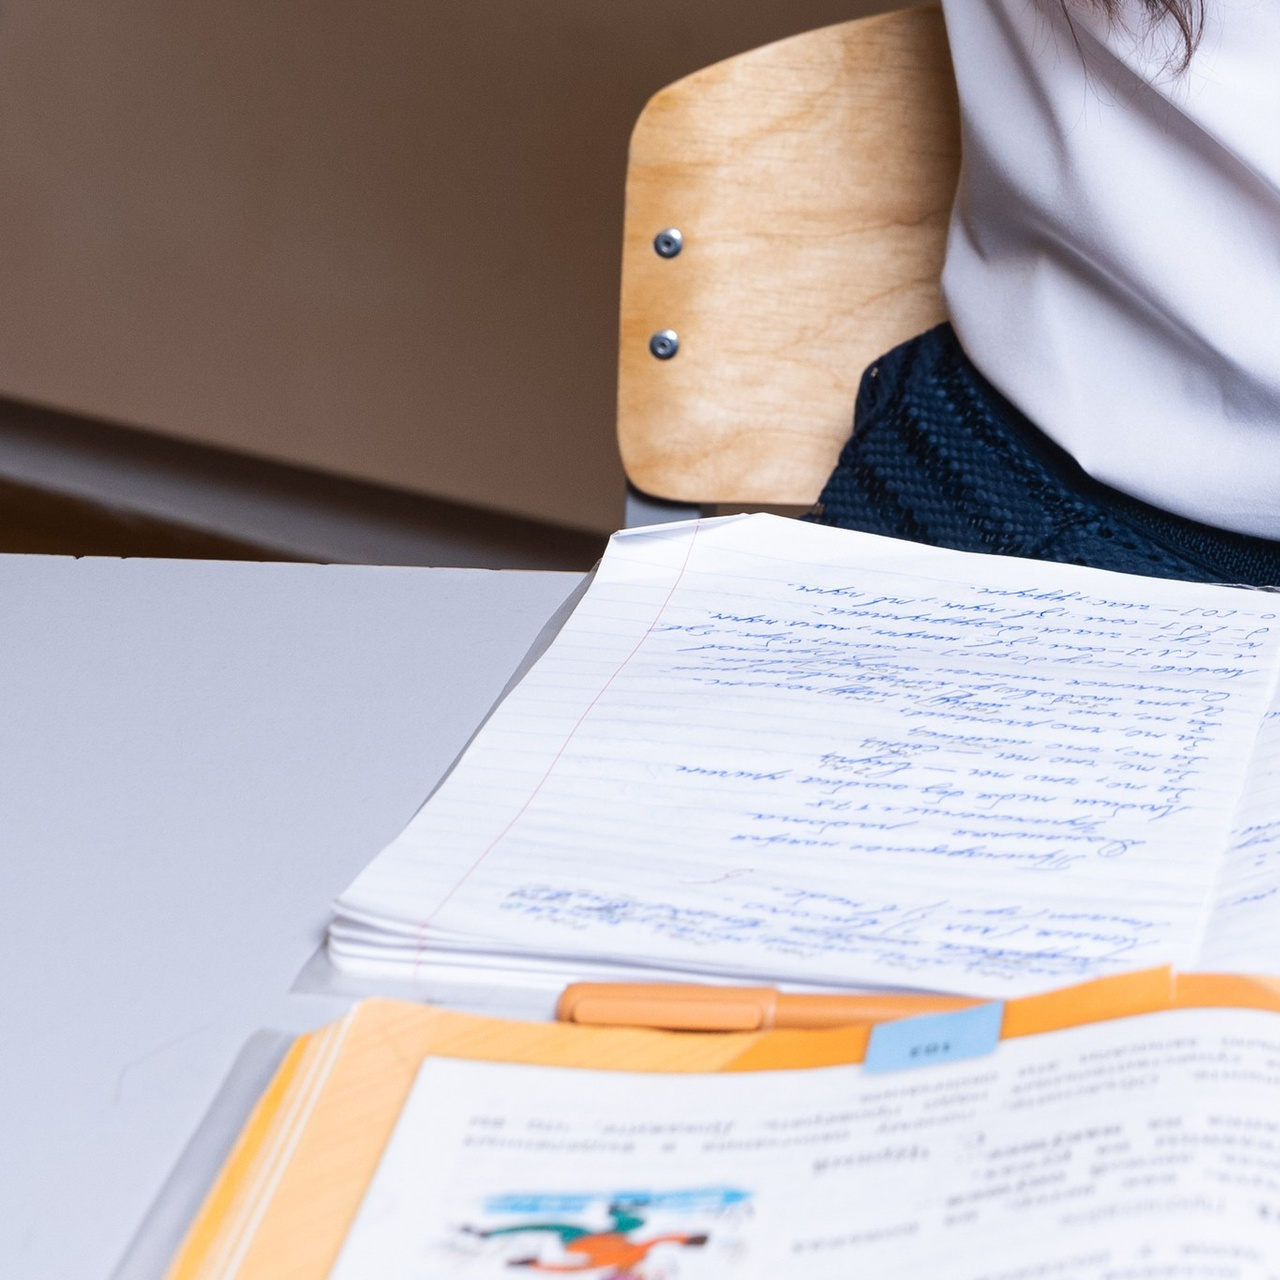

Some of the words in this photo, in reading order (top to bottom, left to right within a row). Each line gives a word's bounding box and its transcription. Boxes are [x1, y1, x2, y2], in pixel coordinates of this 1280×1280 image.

[1136, 663, 1259, 680] Любовь
[1064, 679, 1232, 702] Останется
[1072, 798, 1192, 822] Любили
[742, 814, 920, 835] работа
[729, 832, 840, 848] ноября
[952, 829, 1147, 858] Домашняя
